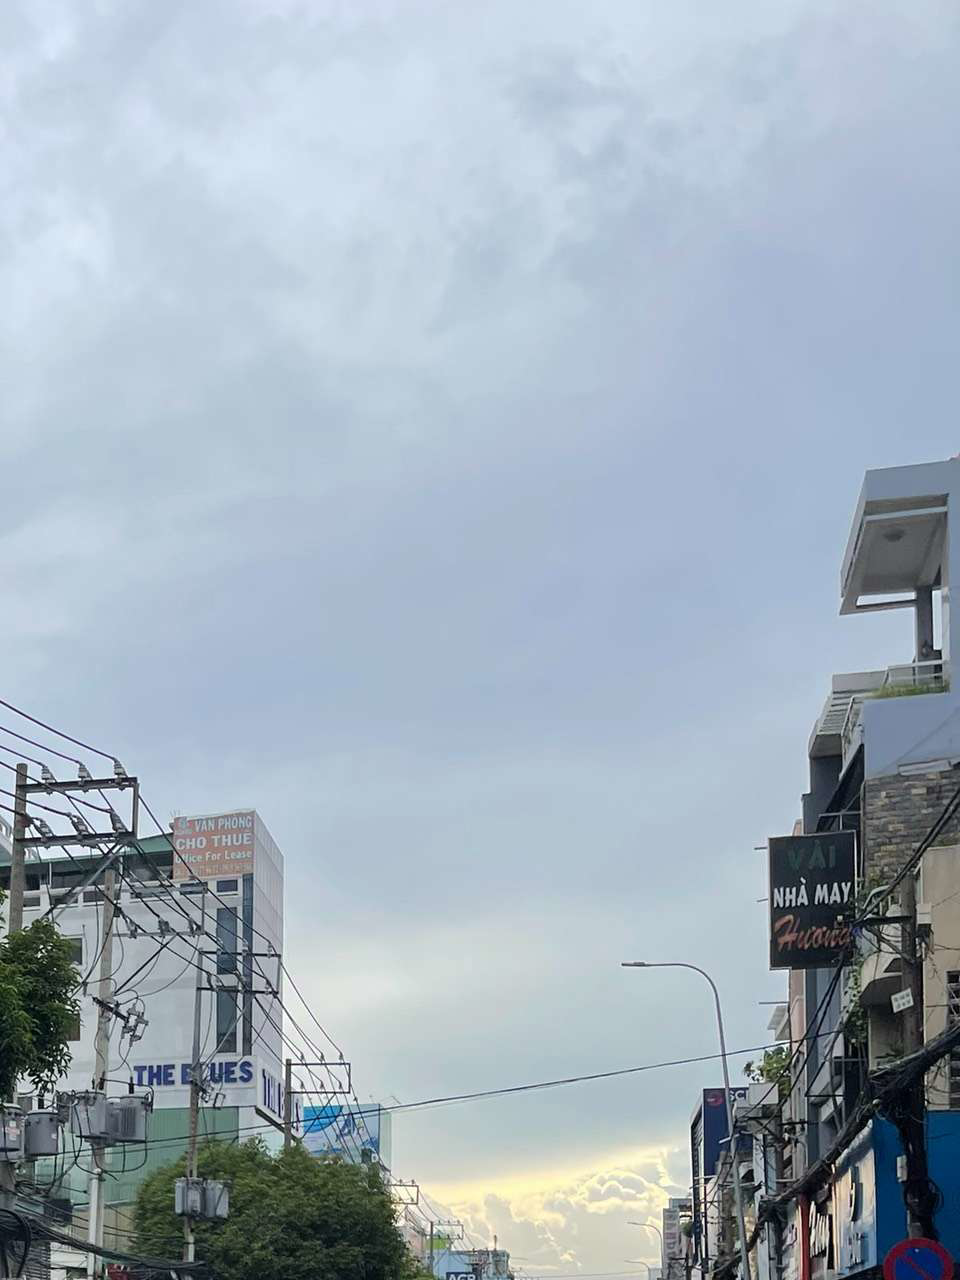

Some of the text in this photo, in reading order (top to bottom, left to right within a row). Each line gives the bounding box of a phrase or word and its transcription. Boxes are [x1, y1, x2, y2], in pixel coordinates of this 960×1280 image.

[175, 836, 207, 850] CHO
[206, 851, 221, 861] For
[224, 850, 252, 860] Lease
[773, 876, 852, 908] NHÀ MAY
[134, 1061, 253, 1086] THE BUES
